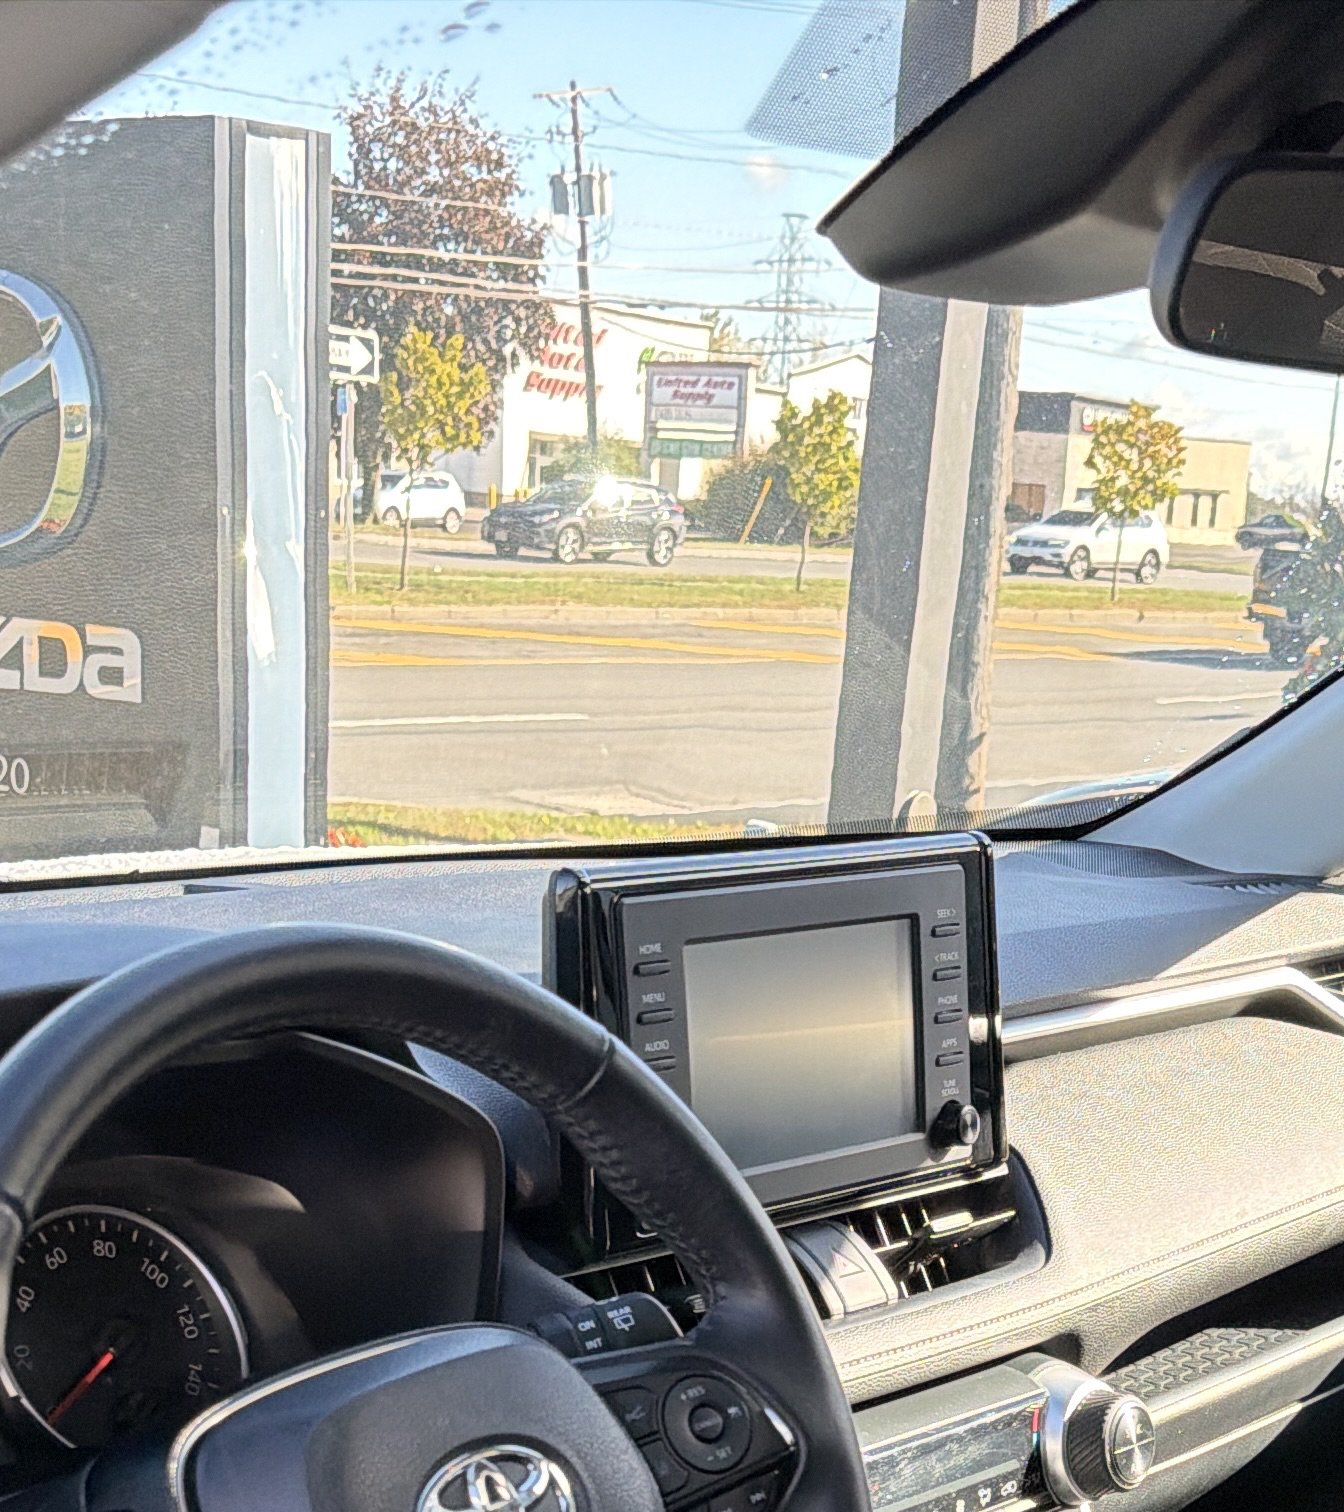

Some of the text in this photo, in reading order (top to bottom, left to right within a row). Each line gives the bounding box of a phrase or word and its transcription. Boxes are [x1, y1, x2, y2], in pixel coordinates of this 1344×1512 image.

[657, 377, 736, 391] United Auto
[672, 390, 715, 404] Supply
[639, 943, 663, 954] HOME
[642, 992, 666, 1003] MENU
[938, 995, 958, 1005] PHONE
[645, 1040, 670, 1052] AUDIO
[941, 1038, 958, 1048] APPS
[92, 1239, 116, 1258] 80
[45, 1247, 68, 1270] 60
[140, 1257, 169, 1288] 100
[16, 1285, 35, 1312] 40
[607, 1305, 632, 1319] REAR
[176, 1304, 199, 1339] 120
[577, 1320, 596, 1332] ON
[585, 1337, 603, 1350] INT
[14, 1344, 33, 1370] 20
[184, 1362, 203, 1396] 140
